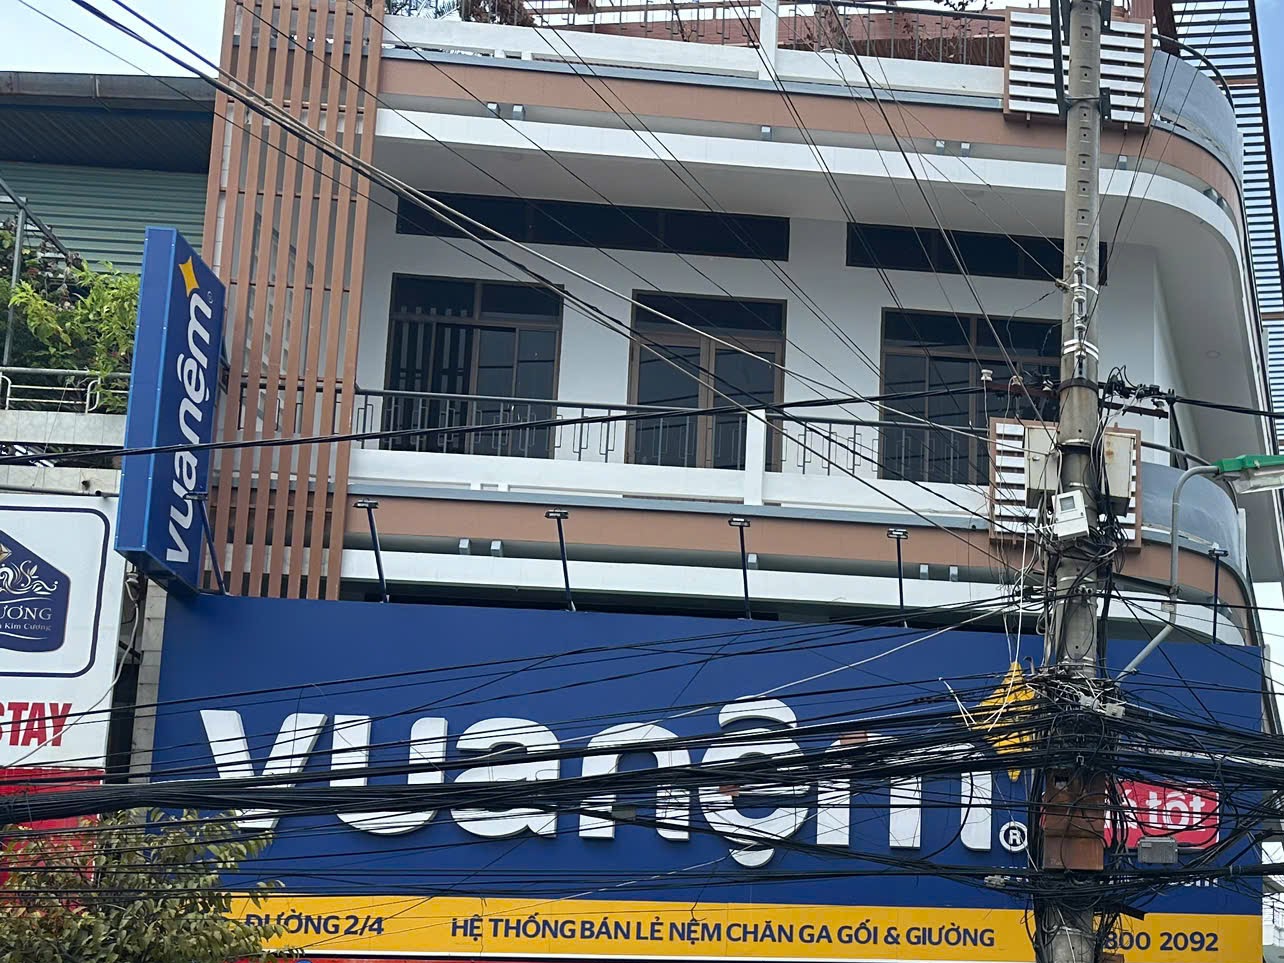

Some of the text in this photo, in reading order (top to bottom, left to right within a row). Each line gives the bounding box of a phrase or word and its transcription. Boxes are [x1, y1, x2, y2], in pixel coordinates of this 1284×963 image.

[345, 915, 384, 936] 2/4
[451, 913, 995, 946] HỆ THỐNG BÁN LẺ NỆM CHĂN GA GỐI & GIƯỜNG
[1159, 932, 1218, 952] 2092
